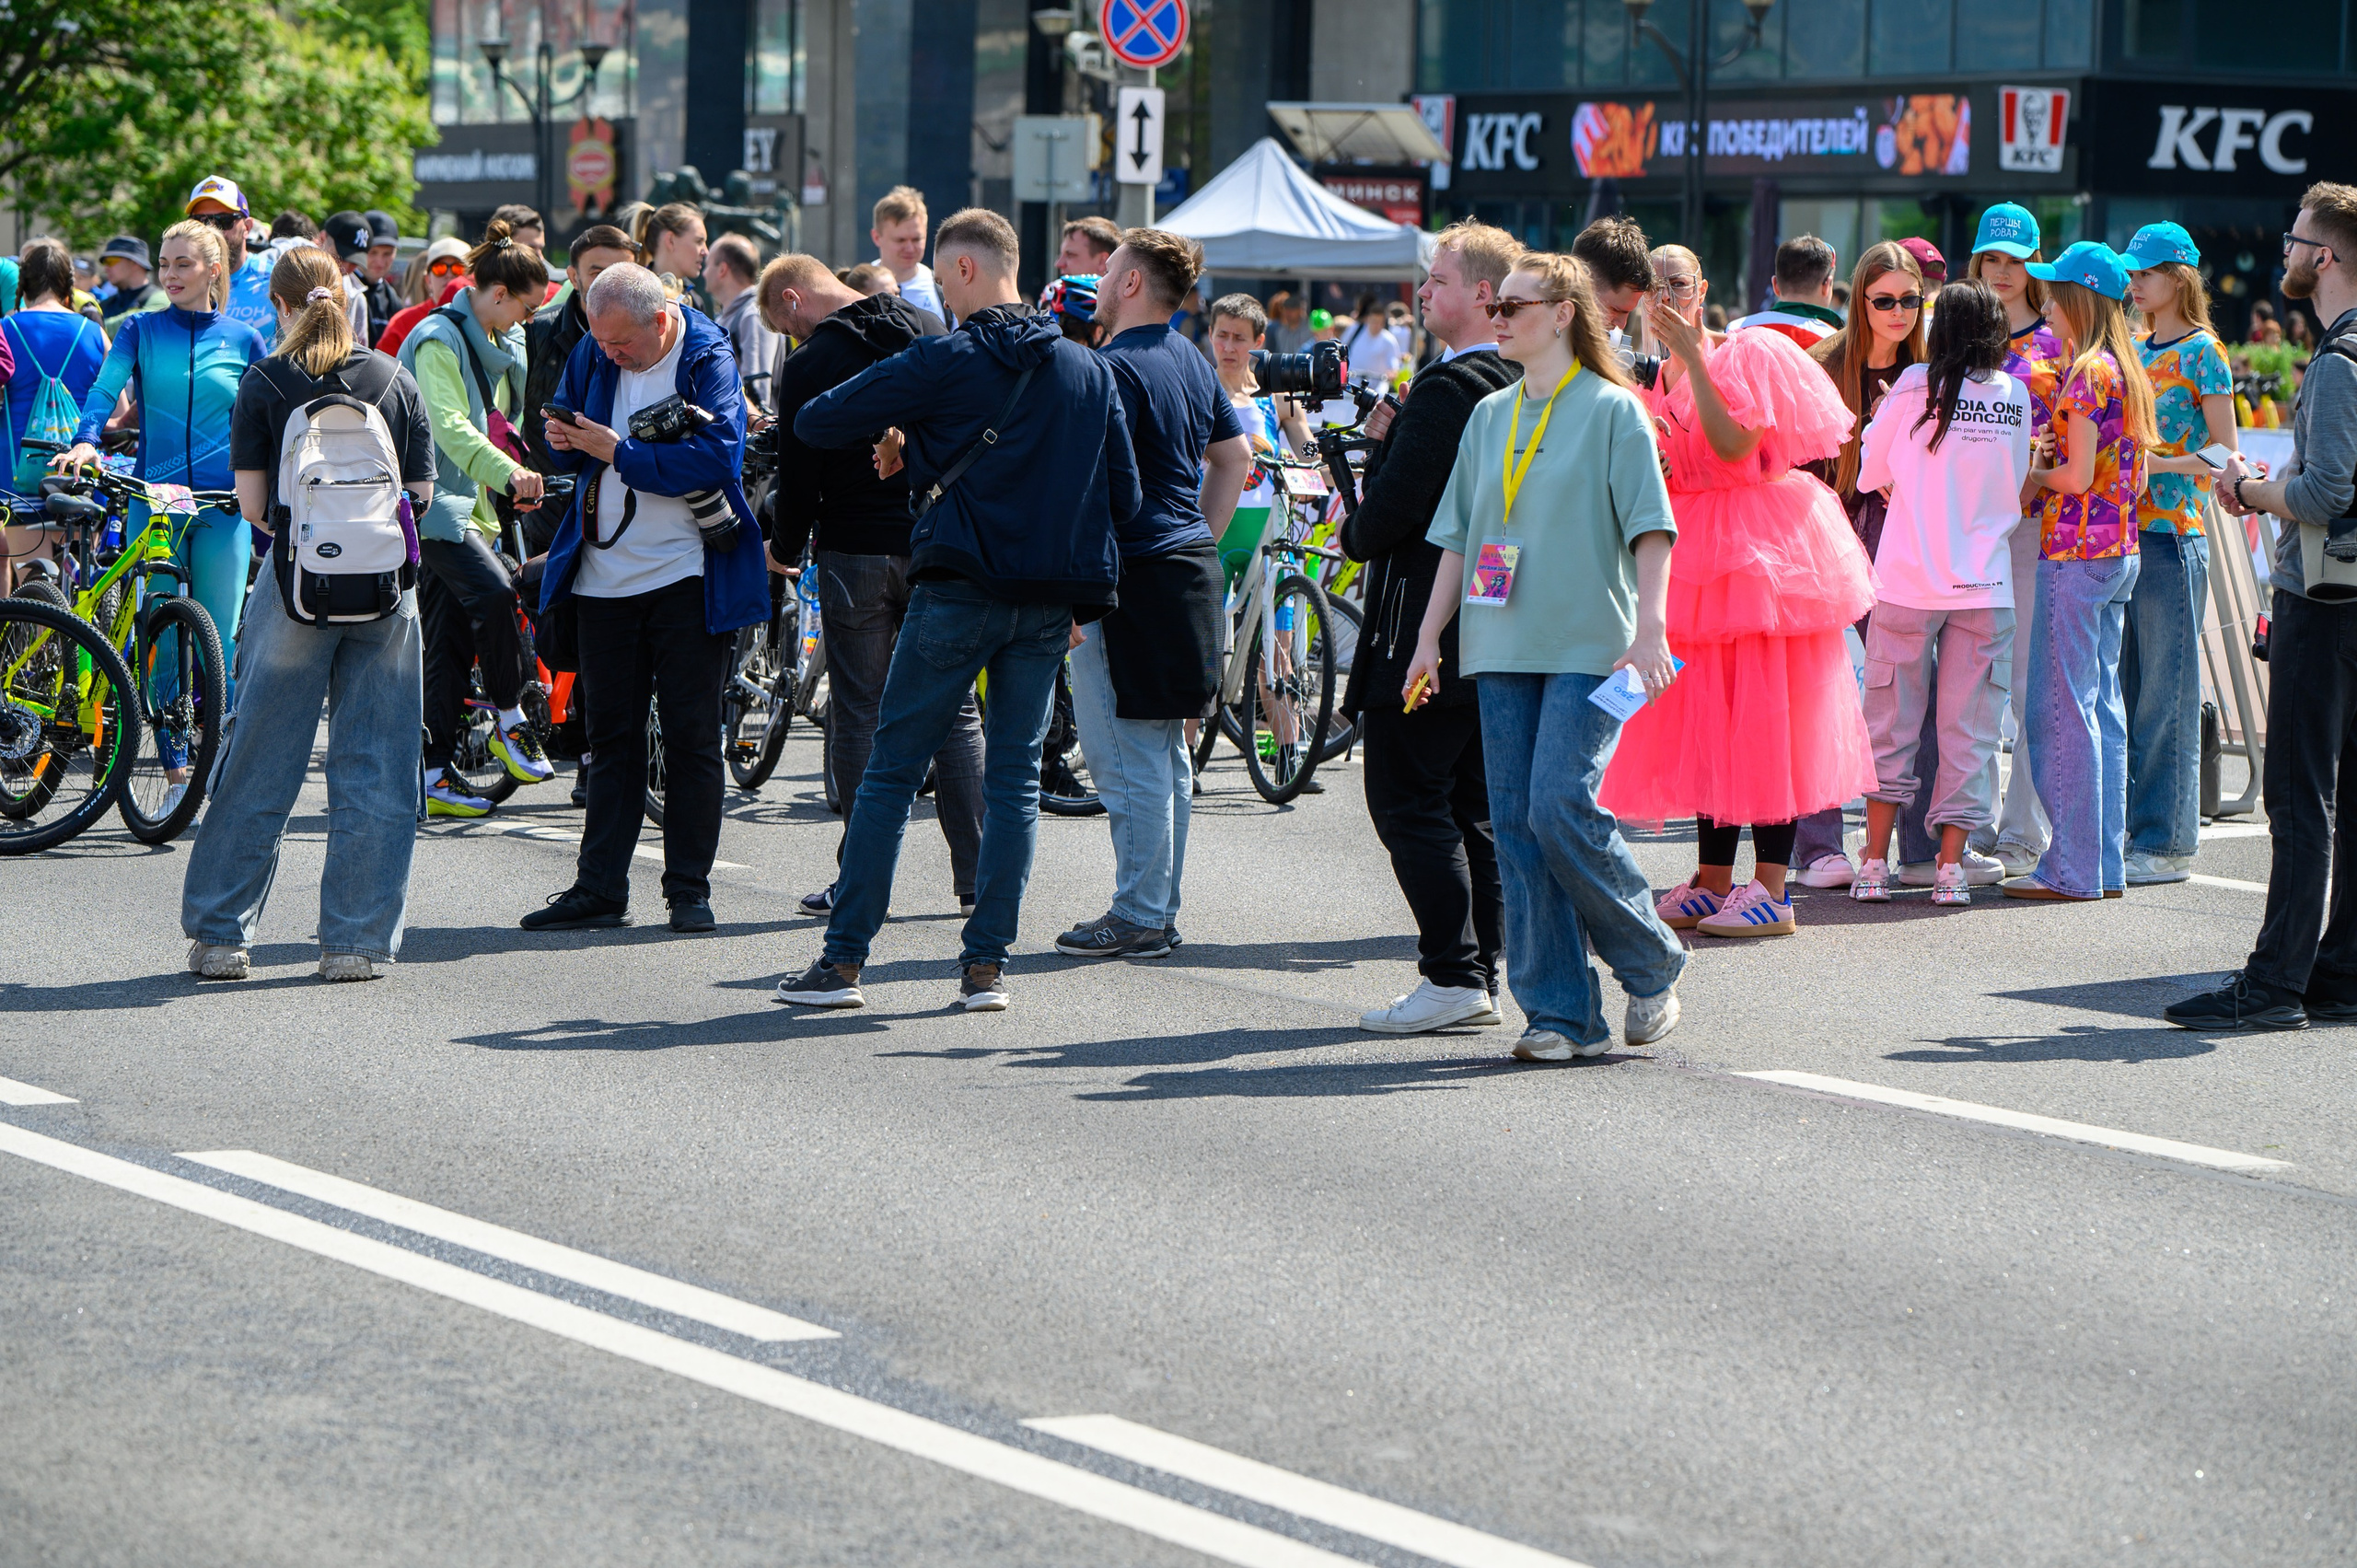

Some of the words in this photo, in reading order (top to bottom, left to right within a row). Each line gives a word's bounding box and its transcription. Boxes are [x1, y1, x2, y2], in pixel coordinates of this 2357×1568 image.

[1461, 112, 1542, 170] KFC
[1707, 106, 1869, 161] ПОБЕДИТЕЛЕЙ
[2147, 105, 2314, 175] KFC
[2012, 149, 2053, 164] KFC
[1990, 227, 2018, 238] РОВАР
[1926, 398, 1988, 412] MDIA
[1992, 401, 2024, 418] ONE
[1961, 435, 1998, 443] drugomu?
[1613, 686, 1635, 702] 250
